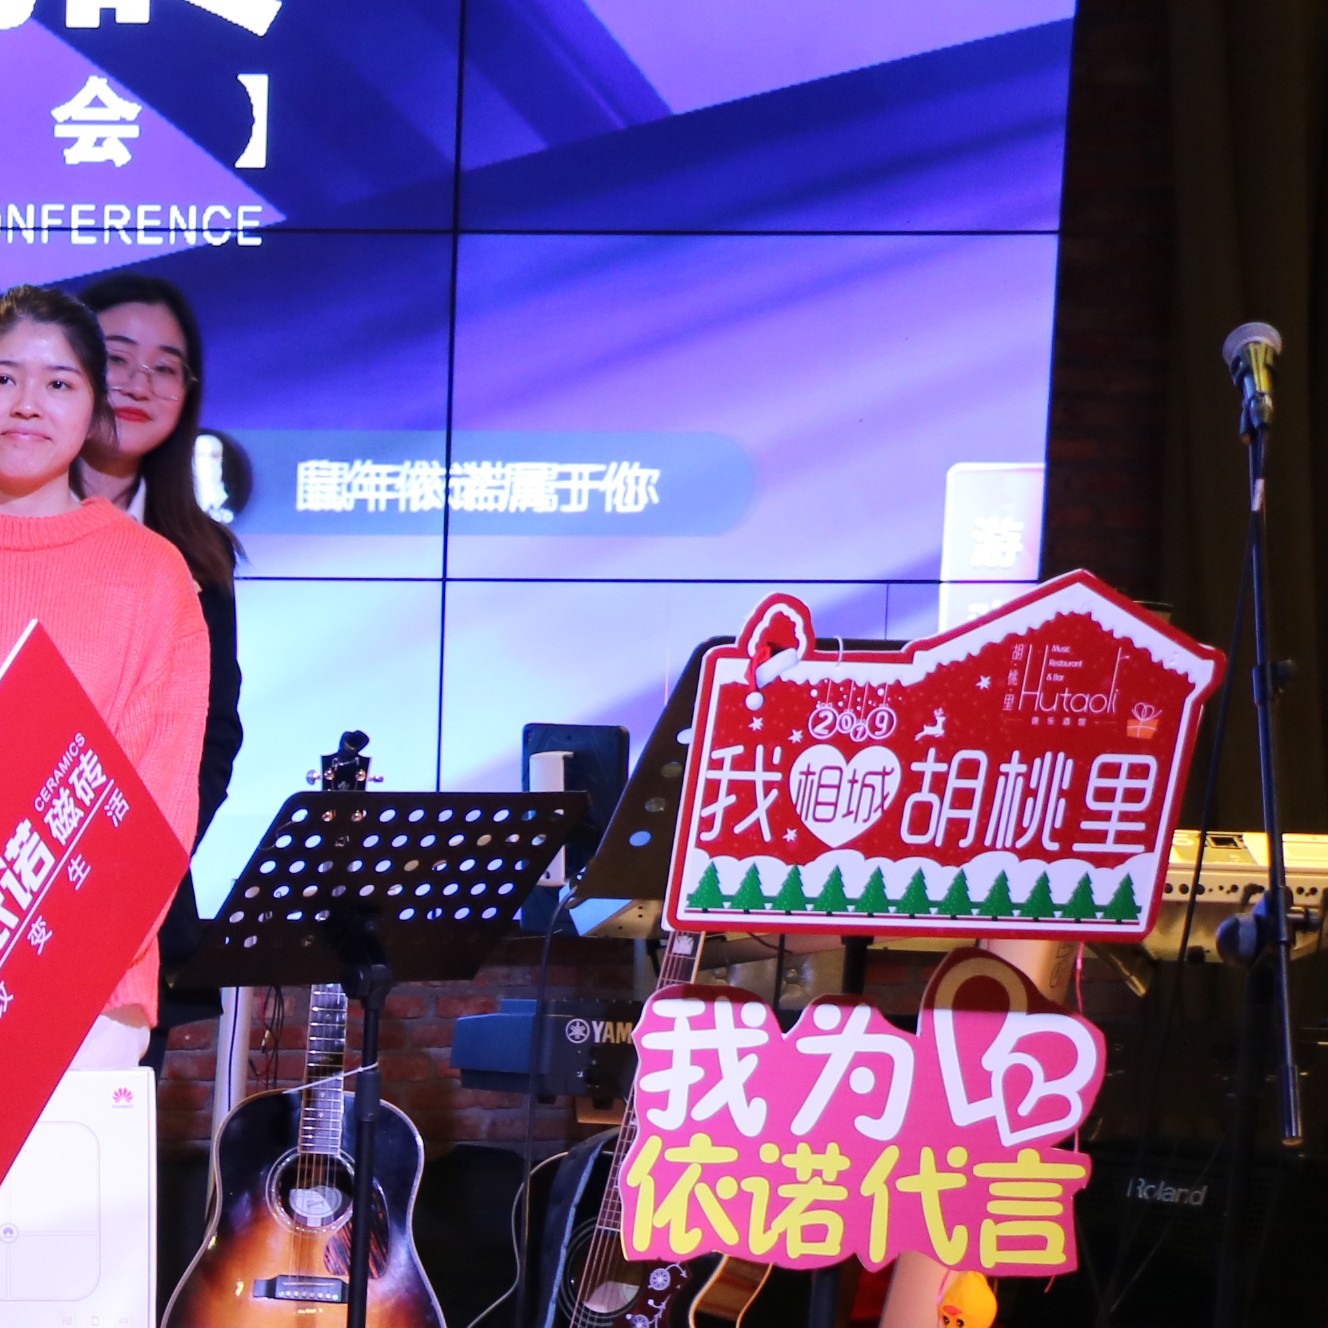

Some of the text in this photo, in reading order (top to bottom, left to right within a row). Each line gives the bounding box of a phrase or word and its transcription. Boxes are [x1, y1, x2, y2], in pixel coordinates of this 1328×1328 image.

[33, 732, 86, 813] CERAMICS
[42, 749, 108, 847] 磁砖
[591, 1020, 634, 1045] YAM
[624, 1132, 1087, 1267] 依诺代言
